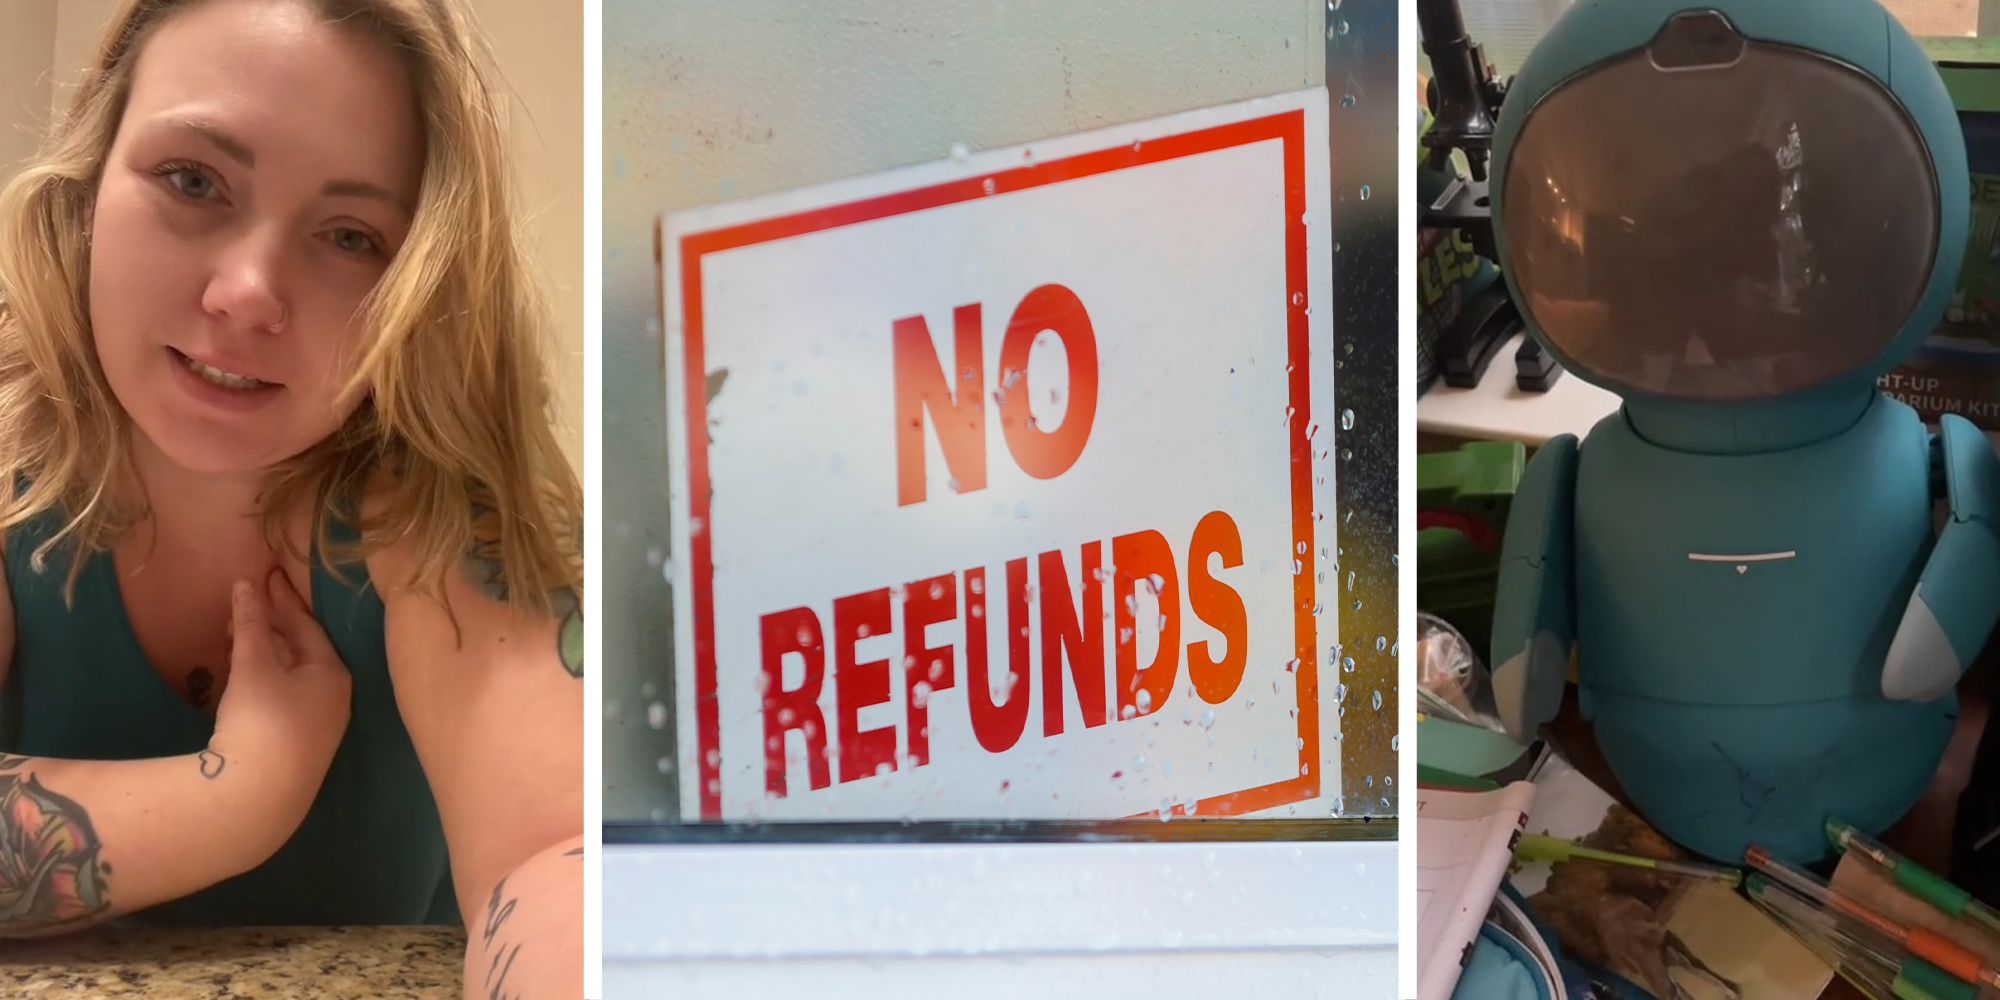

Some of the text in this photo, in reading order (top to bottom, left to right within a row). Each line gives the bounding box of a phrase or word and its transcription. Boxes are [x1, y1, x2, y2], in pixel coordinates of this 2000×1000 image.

[1417, 228, 1481, 316] LES
[892, 283, 1099, 507] NO
[1876, 373, 1940, 392] HT-UP
[1968, 400, 2000, 417] KIT
[758, 510, 1248, 799] REFUNDS
